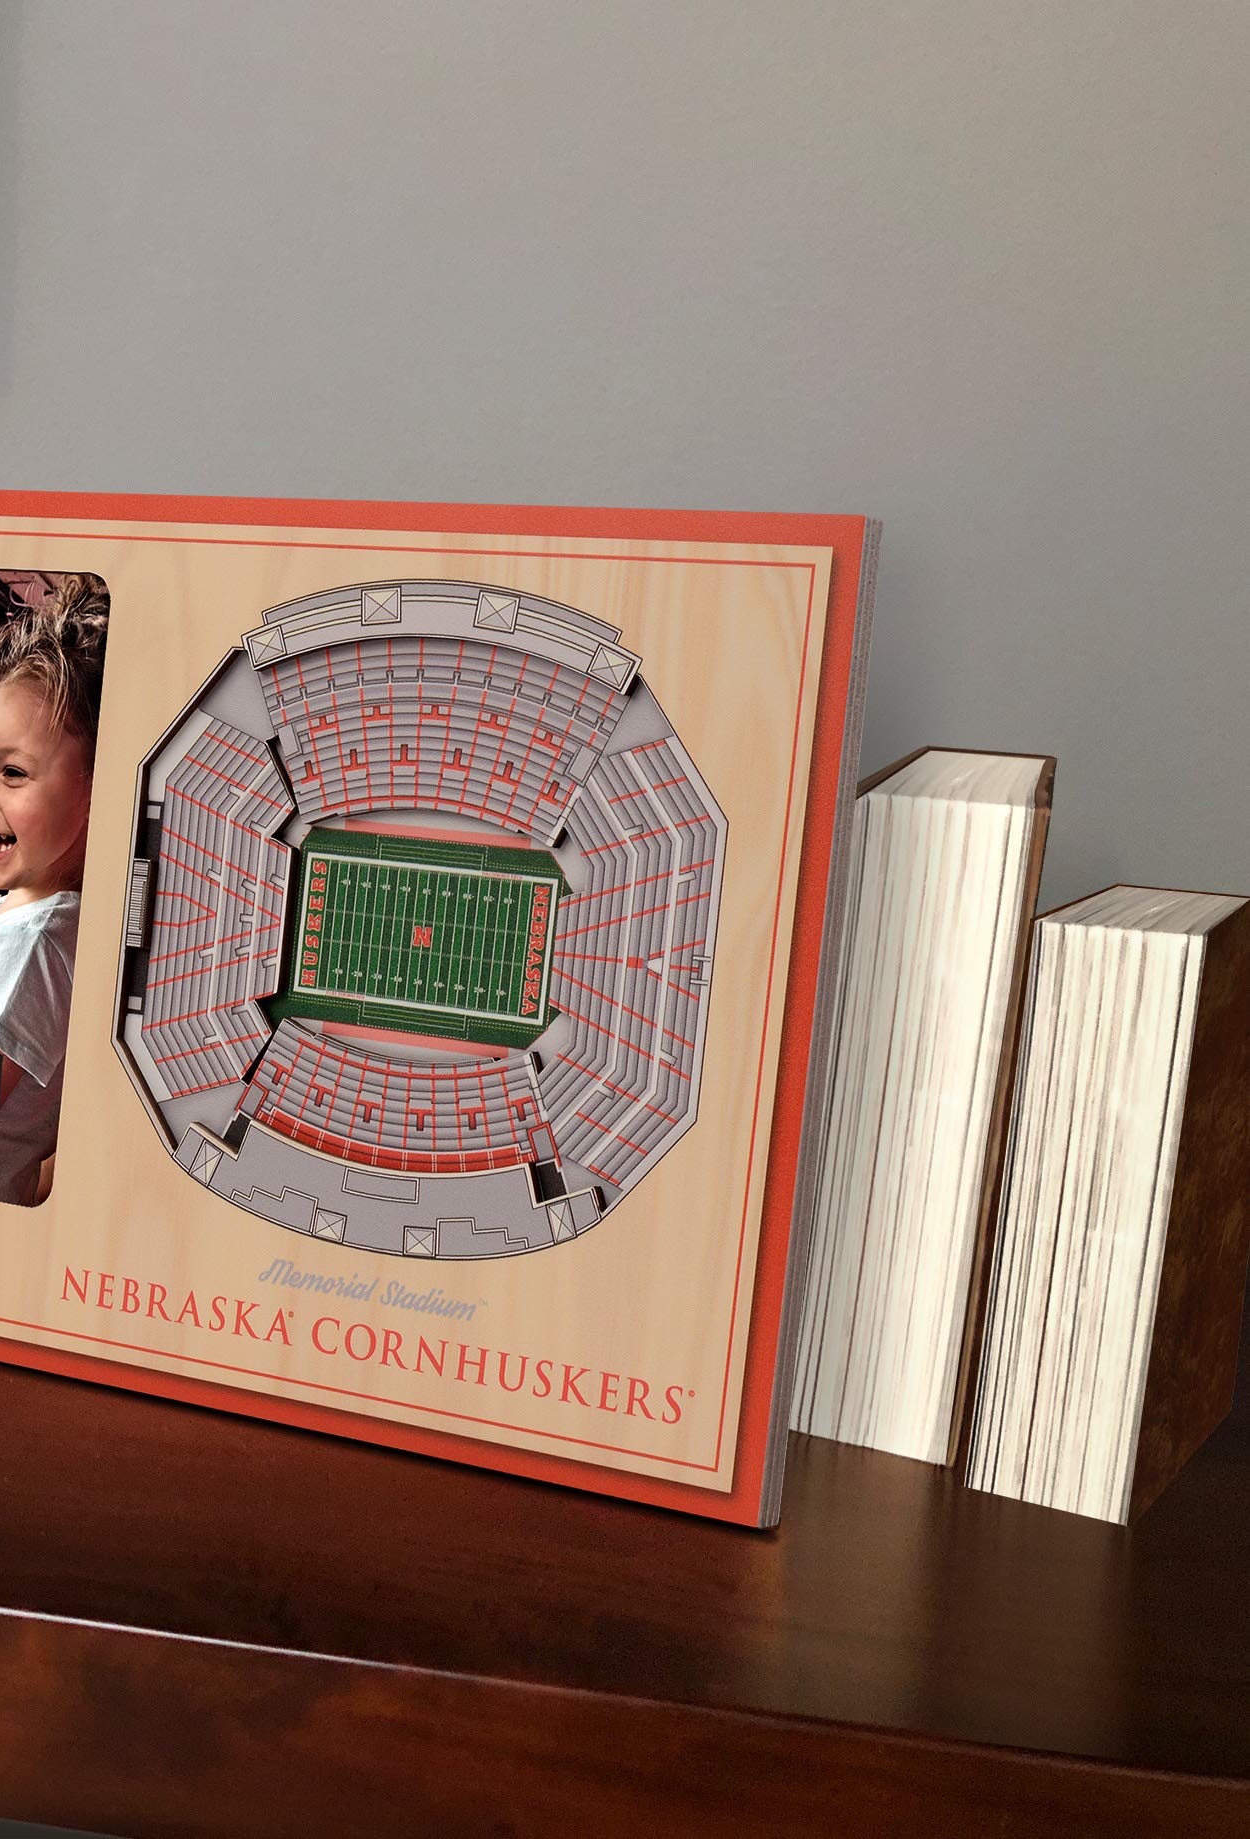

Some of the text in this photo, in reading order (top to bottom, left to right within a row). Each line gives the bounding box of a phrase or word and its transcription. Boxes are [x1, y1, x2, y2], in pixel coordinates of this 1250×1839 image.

[300, 860, 328, 987] HUSKERS
[411, 925, 434, 949] N
[521, 885, 551, 1015] NEBRASKA
[60, 1265, 686, 1426] NEBRASKA CORNHUSKERS
[258, 1258, 478, 1322] Memorial Stadium
